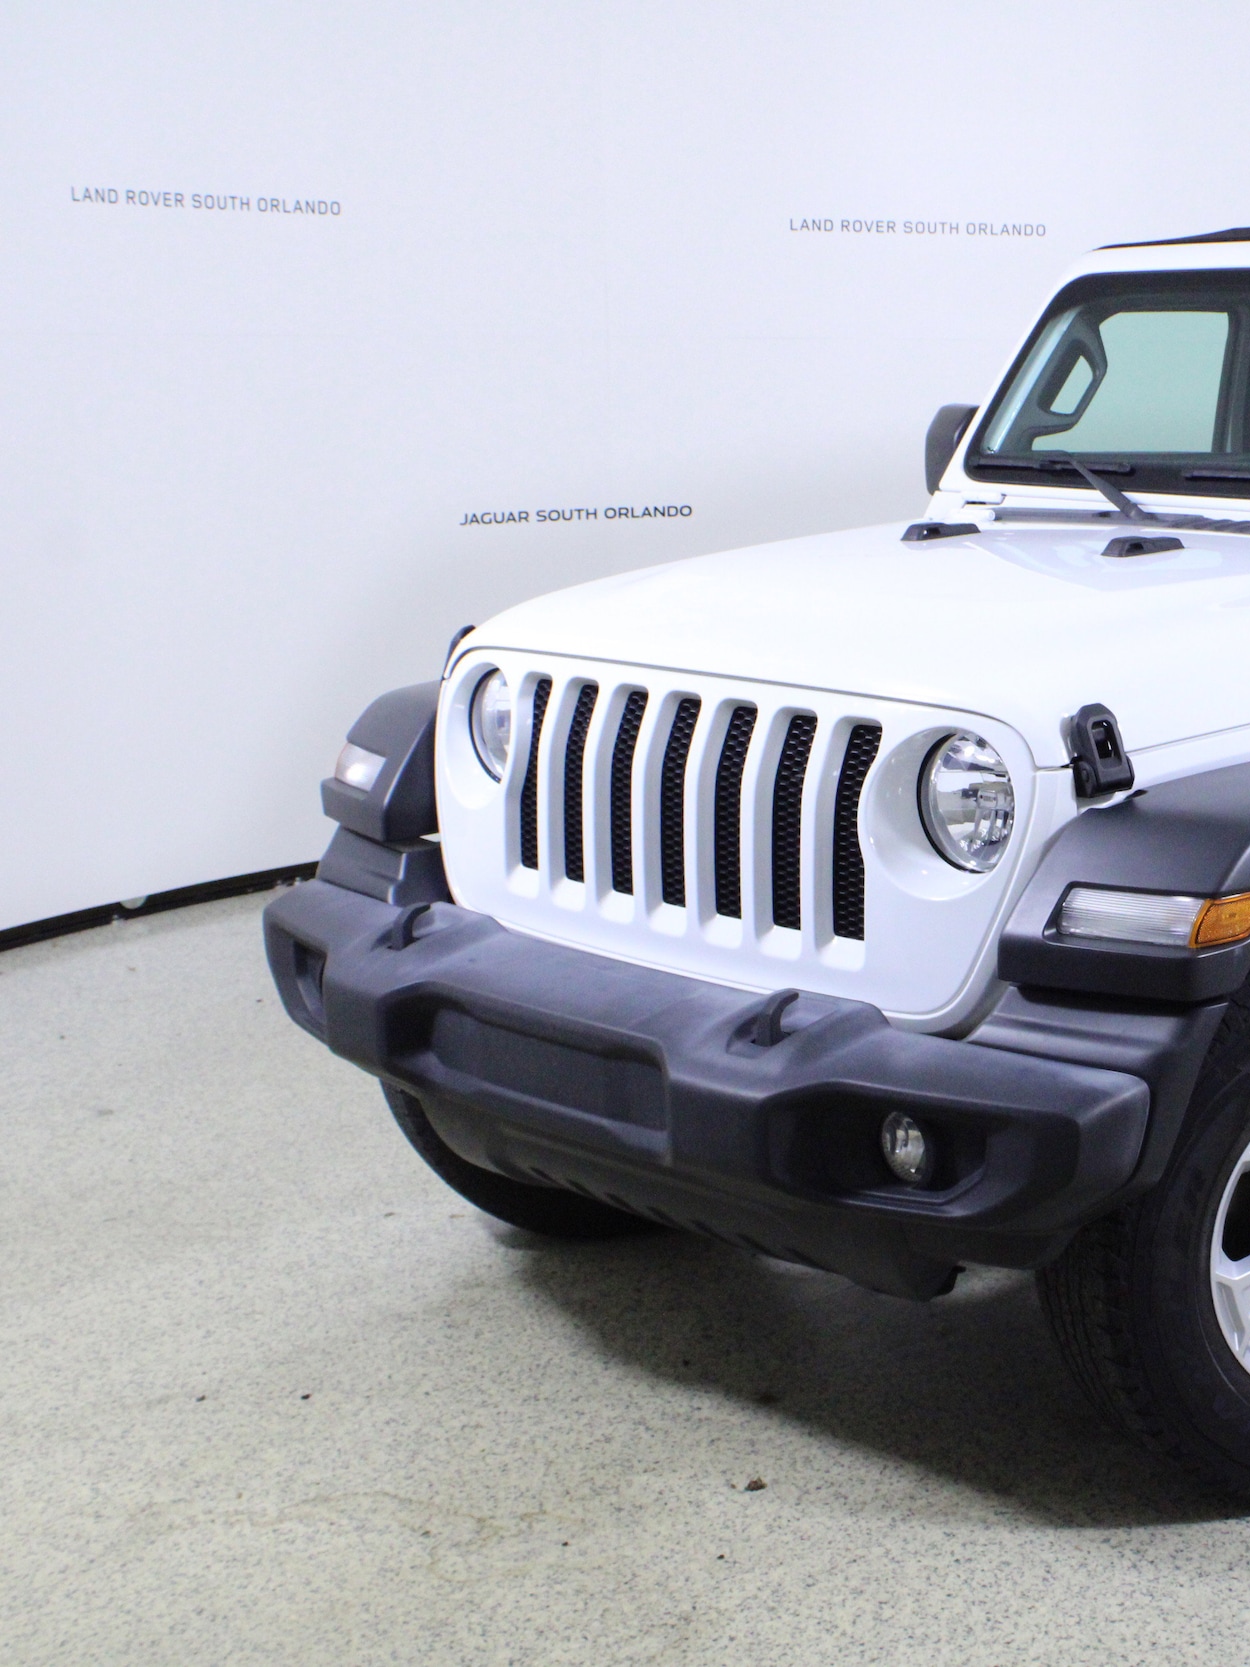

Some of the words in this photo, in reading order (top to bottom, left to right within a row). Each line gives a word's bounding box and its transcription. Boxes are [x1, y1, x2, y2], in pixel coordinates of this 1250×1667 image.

[71, 186, 119, 205] LAND
[126, 189, 185, 208] ROVER
[191, 193, 251, 213] SOUTH
[257, 196, 342, 217] ORLANDO
[789, 218, 835, 234] LAND
[840, 219, 897, 235] ROVER
[902, 220, 960, 236] SOUTH
[965, 222, 1047, 238] ORLANDO
[459, 509, 531, 527] JAGUAR
[535, 507, 599, 523] SOUTH
[603, 504, 694, 521] ORLANDO
